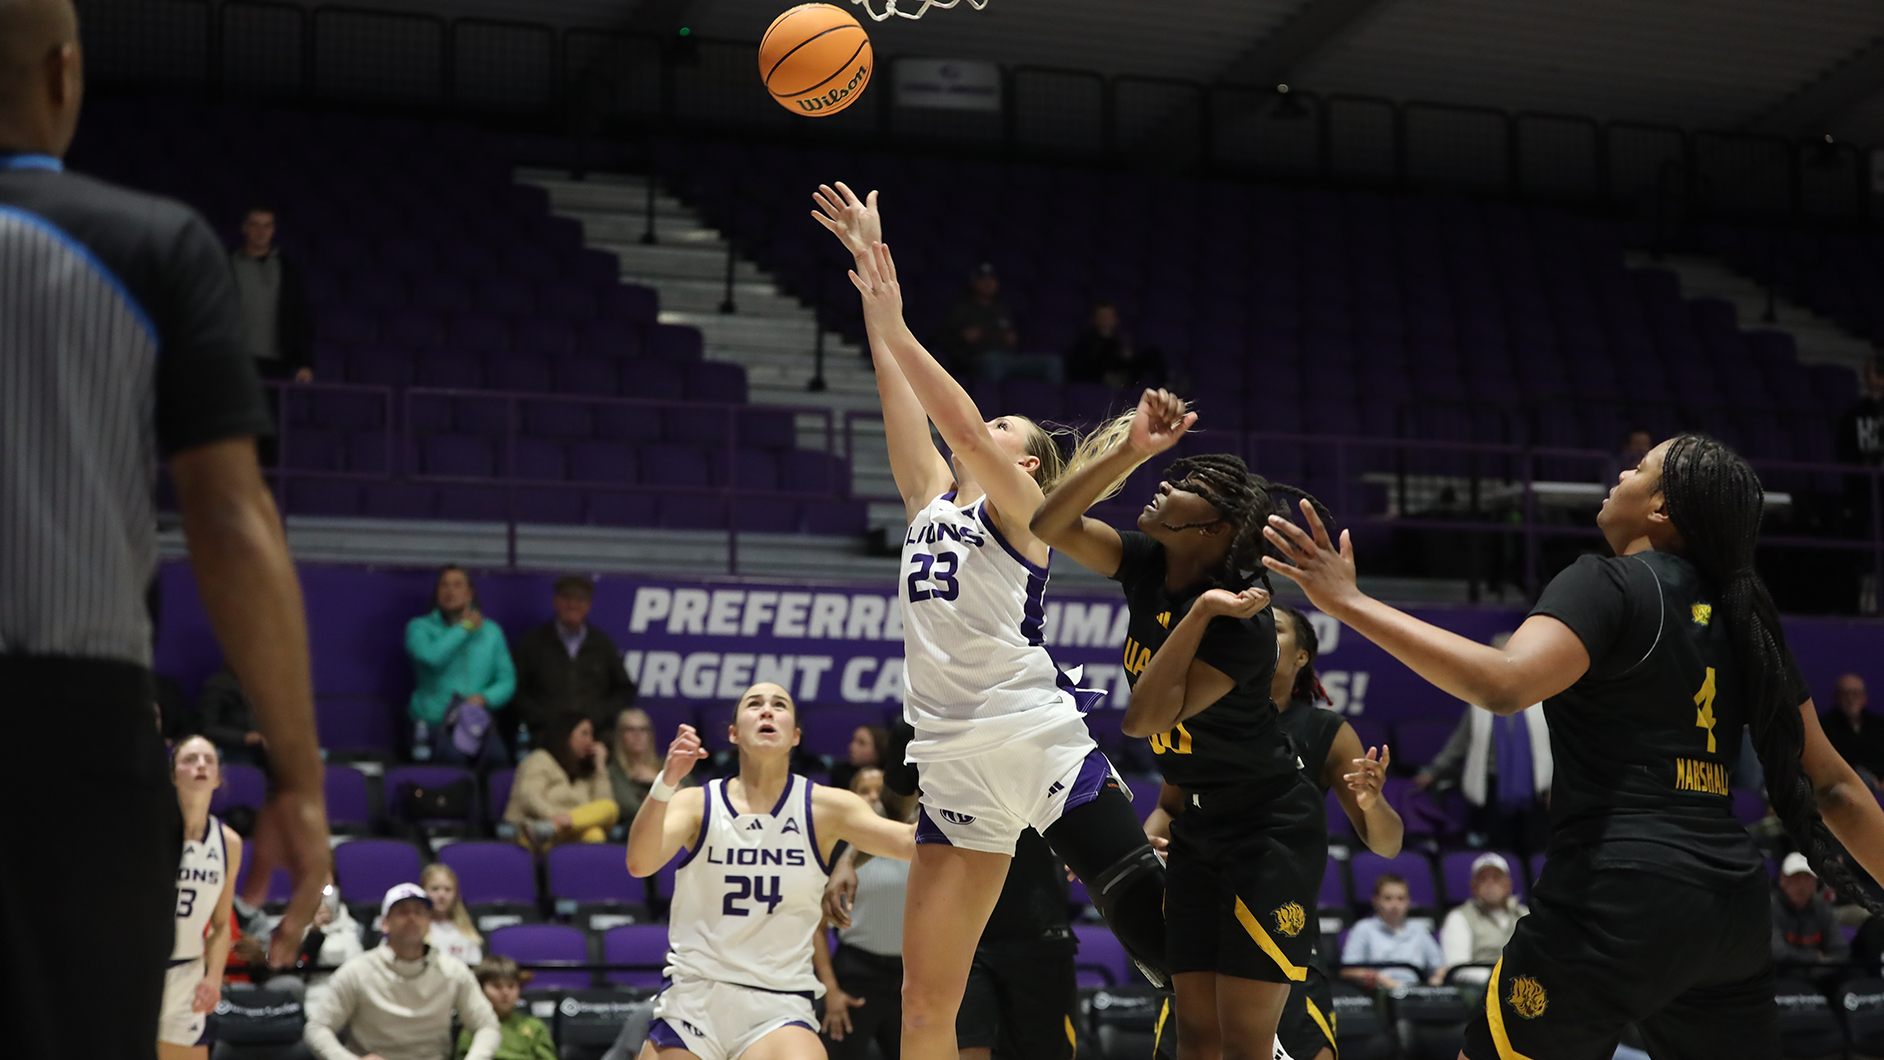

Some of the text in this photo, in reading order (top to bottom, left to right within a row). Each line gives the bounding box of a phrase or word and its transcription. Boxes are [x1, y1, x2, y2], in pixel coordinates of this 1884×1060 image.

[796, 65, 866, 111] Wilson
[906, 522, 985, 547] LIONS
[907, 551, 959, 603] 23
[1124, 637, 1151, 677] UA
[1694, 666, 1717, 753] 4
[178, 868, 219, 884] ONS
[707, 846, 805, 866] LIONS
[722, 875, 783, 916] 24
